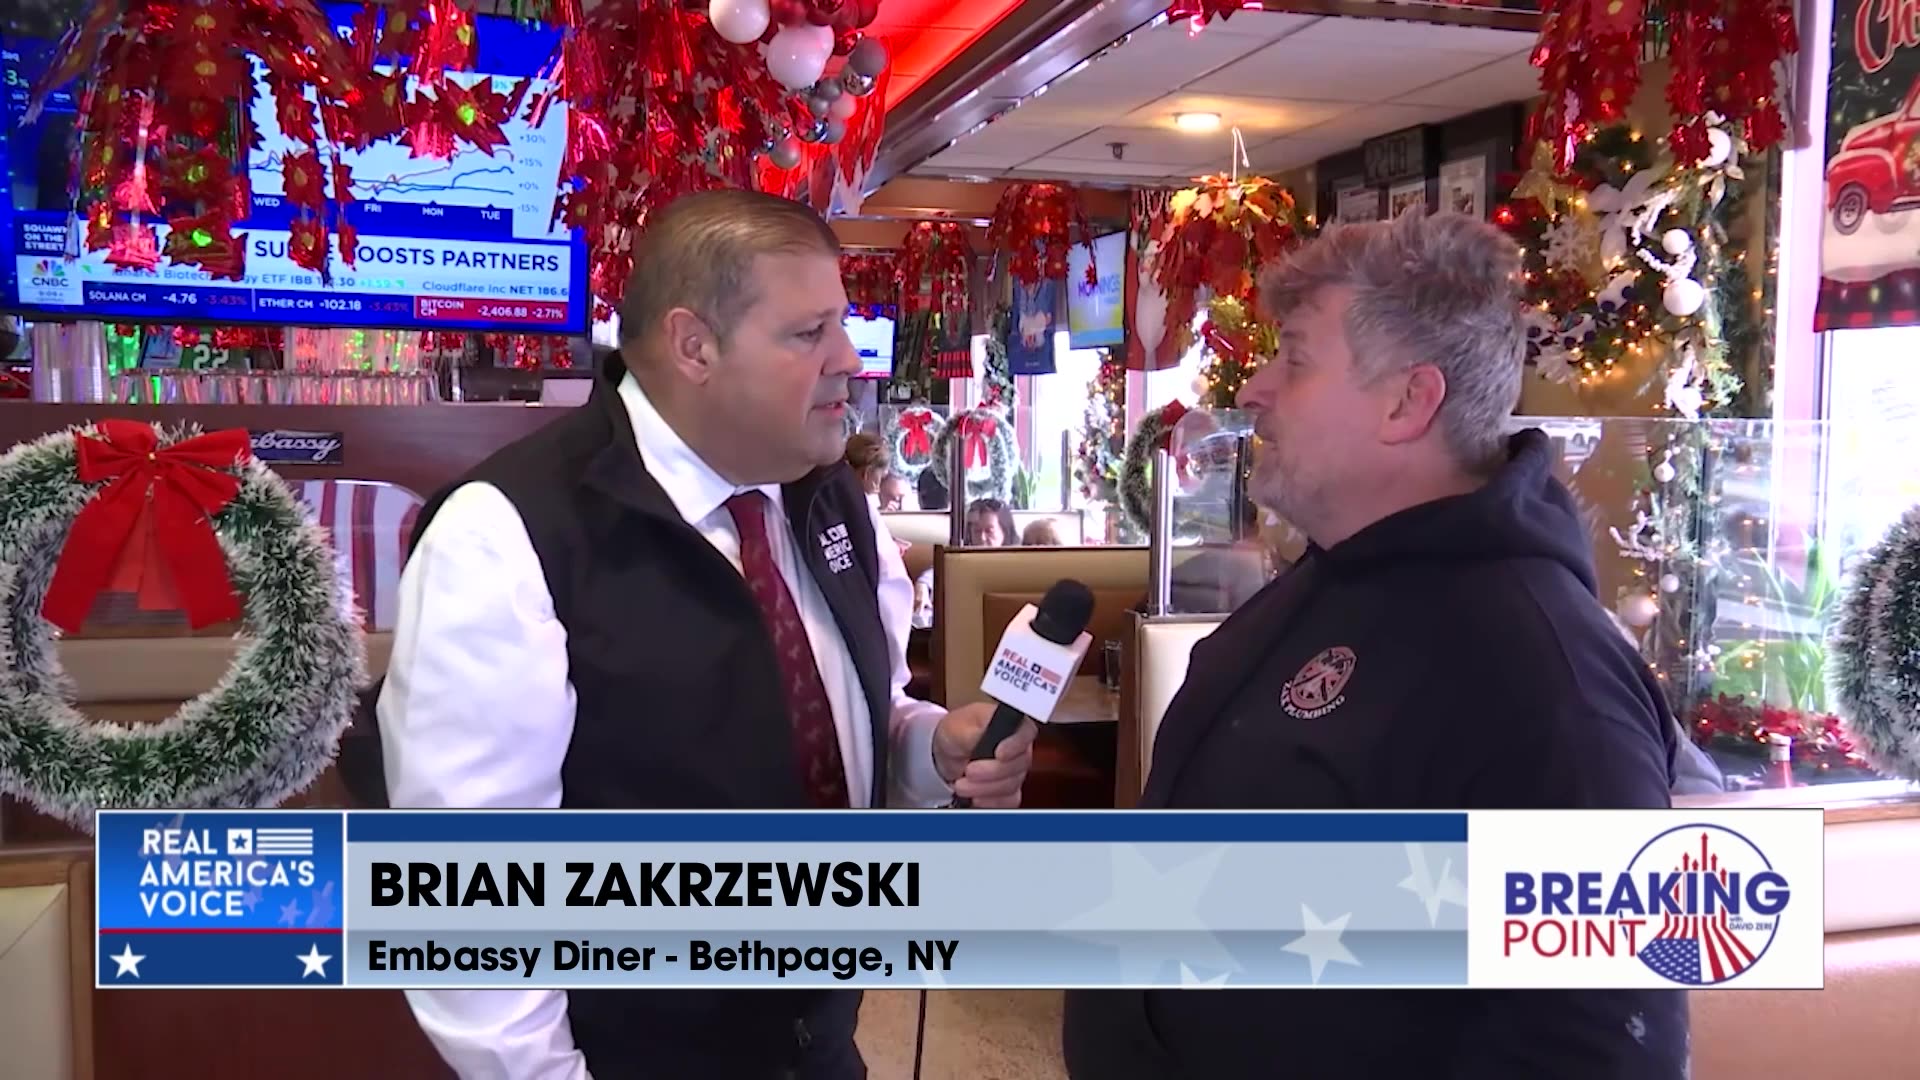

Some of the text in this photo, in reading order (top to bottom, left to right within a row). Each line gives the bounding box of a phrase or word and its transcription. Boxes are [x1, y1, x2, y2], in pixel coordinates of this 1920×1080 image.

[253, 197, 280, 208] WED
[364, 203, 382, 213] FRI
[422, 206, 444, 217] MON
[480, 210, 501, 221] TUE
[24, 233, 64, 242] ON THE
[357, 246, 435, 265] OOSTS
[443, 250, 559, 271] PARTNERS
[31, 276, 69, 287] CNBC
[262, 274, 287, 284] ETF
[291, 275, 313, 285] IBB
[422, 281, 485, 293] Cloudflare
[510, 286, 533, 295] NET
[89, 291, 129, 302] SOLANA
[131, 292, 146, 302] CM
[163, 293, 197, 304] -4.76
[259, 298, 295, 308] ETHER
[297, 299, 313, 309] CM
[319, 299, 362, 311] -102.18
[420, 299, 465, 309] BITCOIN
[420, 308, 437, 316] CM
[477, 306, 563, 319] -2,406.88 -2.71%
[1002, 647, 1030, 669] REAL
[994, 667, 1030, 692] VOICE
[997, 659, 1058, 695] AMERICA'S
